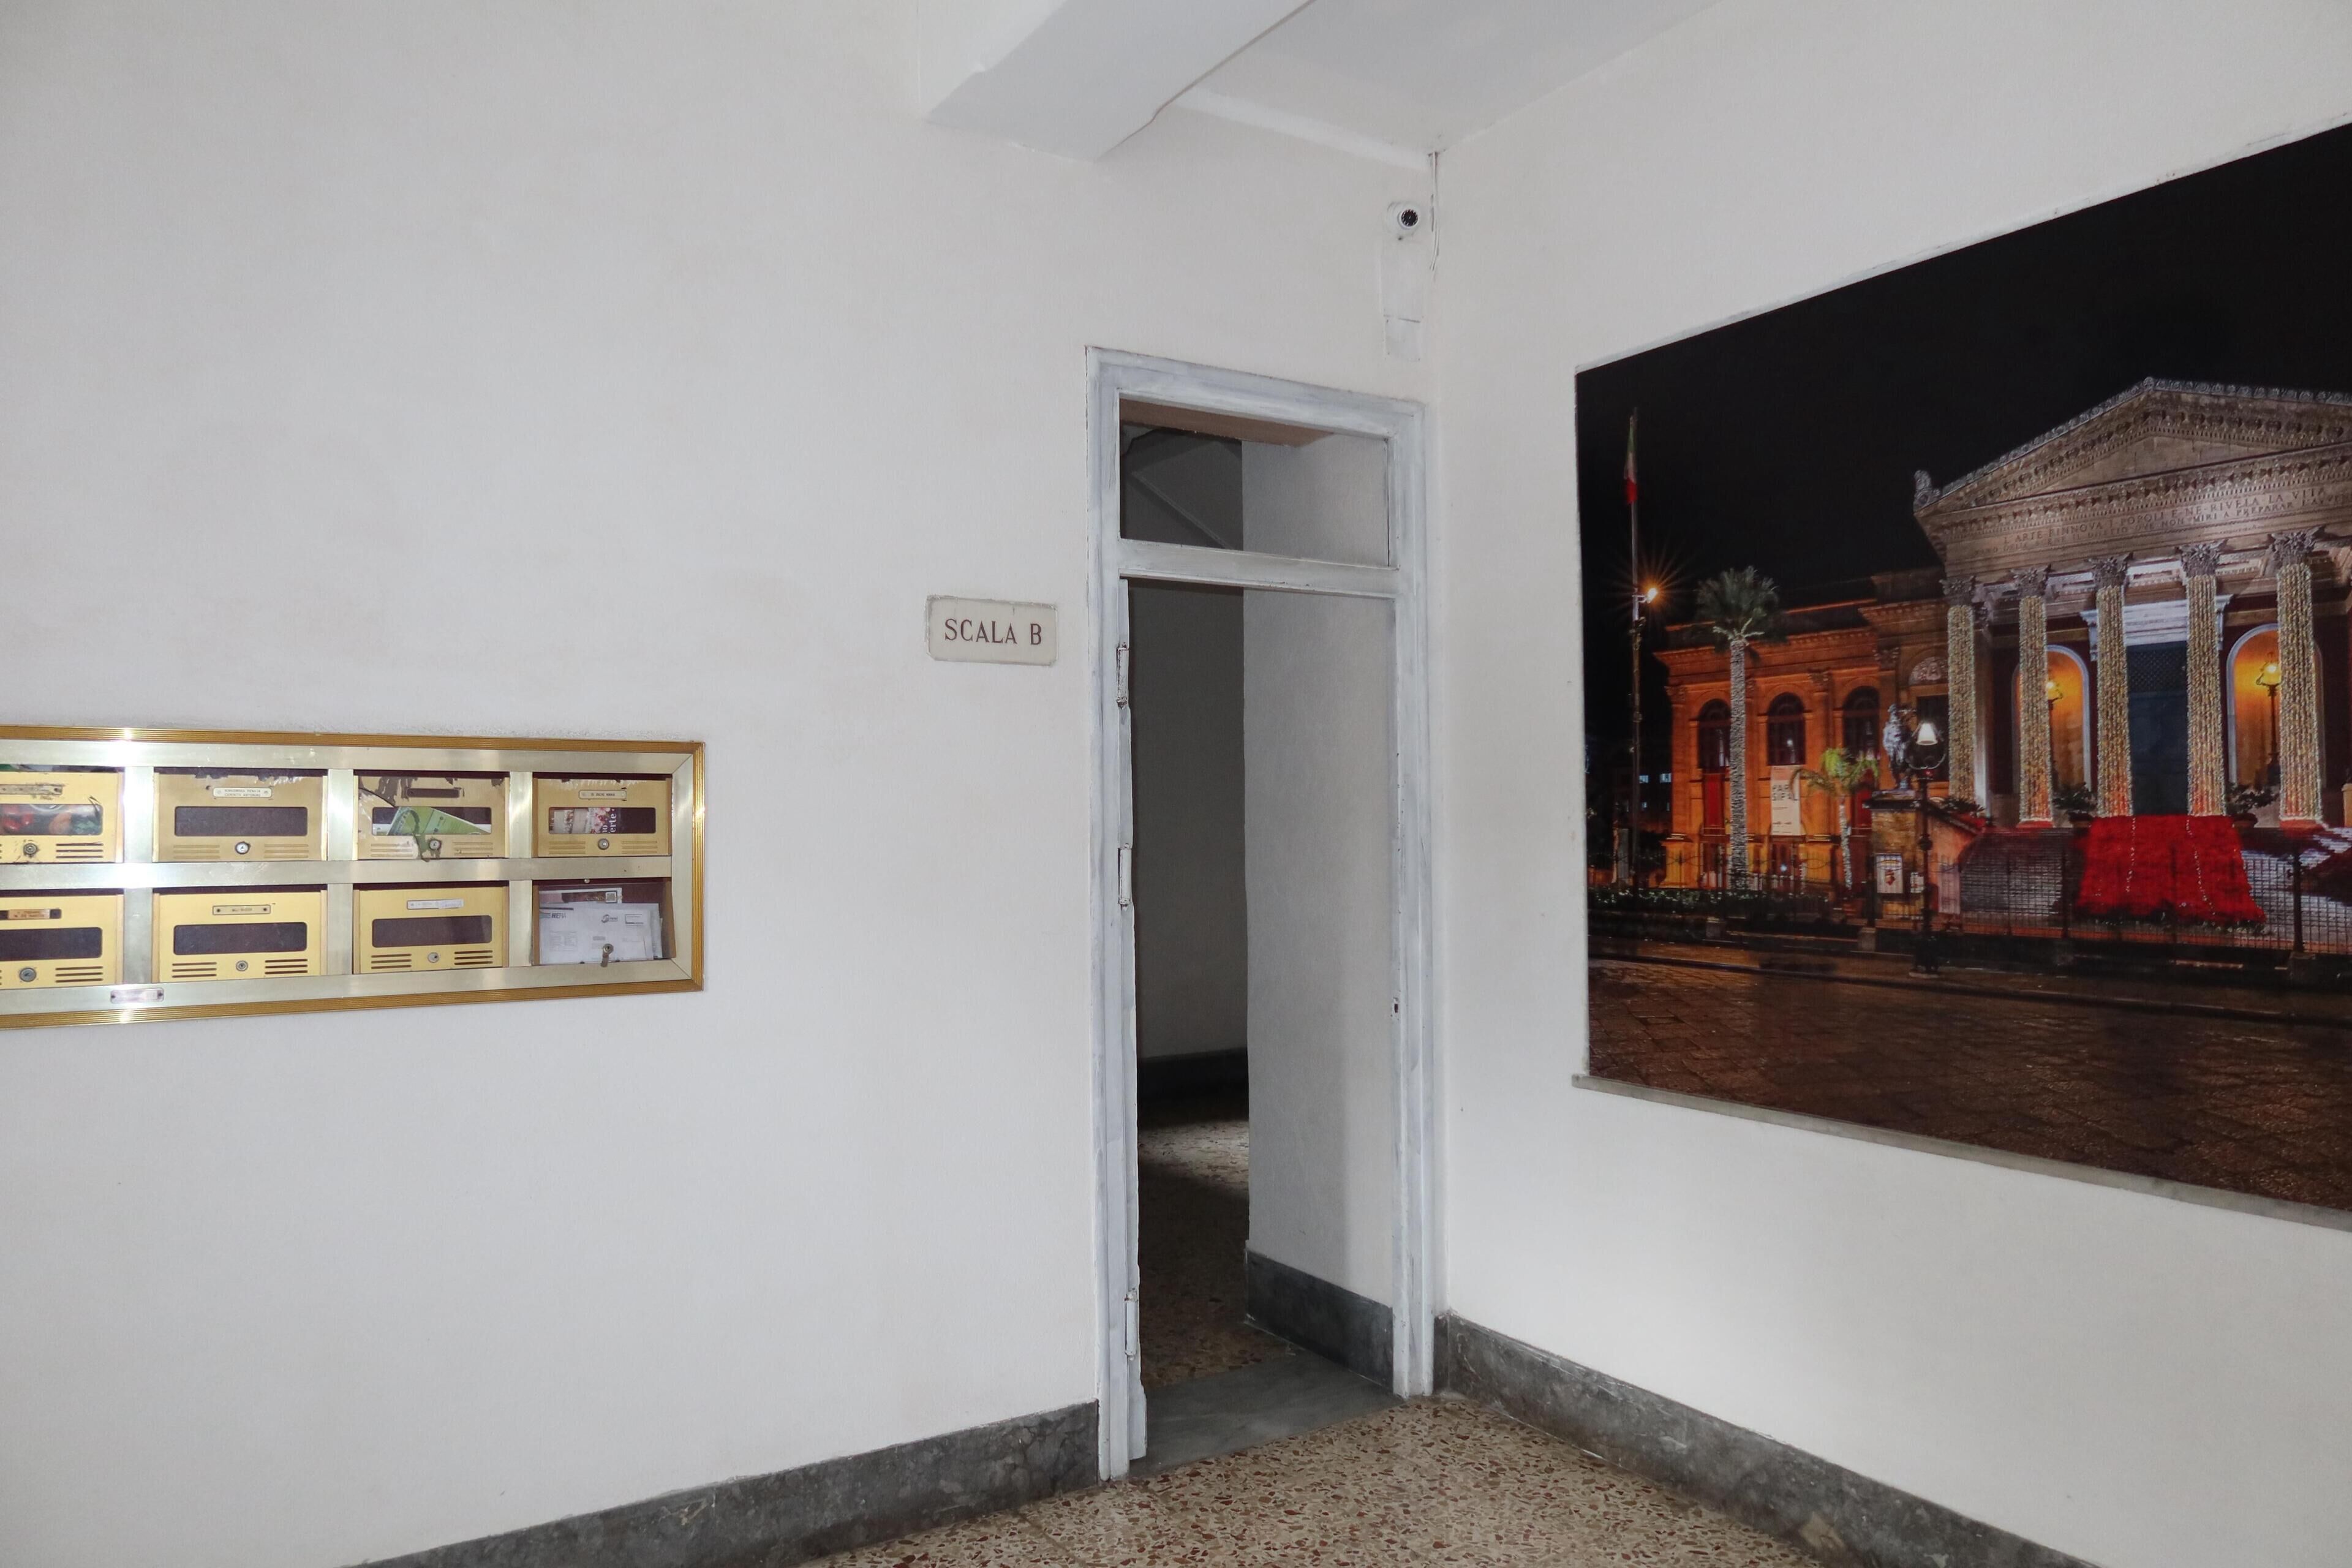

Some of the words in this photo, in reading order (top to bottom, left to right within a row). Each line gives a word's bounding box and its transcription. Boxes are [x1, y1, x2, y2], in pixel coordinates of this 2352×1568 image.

[2015, 530, 2043, 542] ARTE
[2048, 521, 2103, 537] RINNOVA
[2121, 512, 2165, 526] POPOLI
[2211, 497, 2260, 512] RIVELA
[2269, 494, 2285, 503] LA
[2162, 519, 2185, 527] NON
[944, 618, 1017, 644] SCALA
[1030, 623, 1042, 645] B
